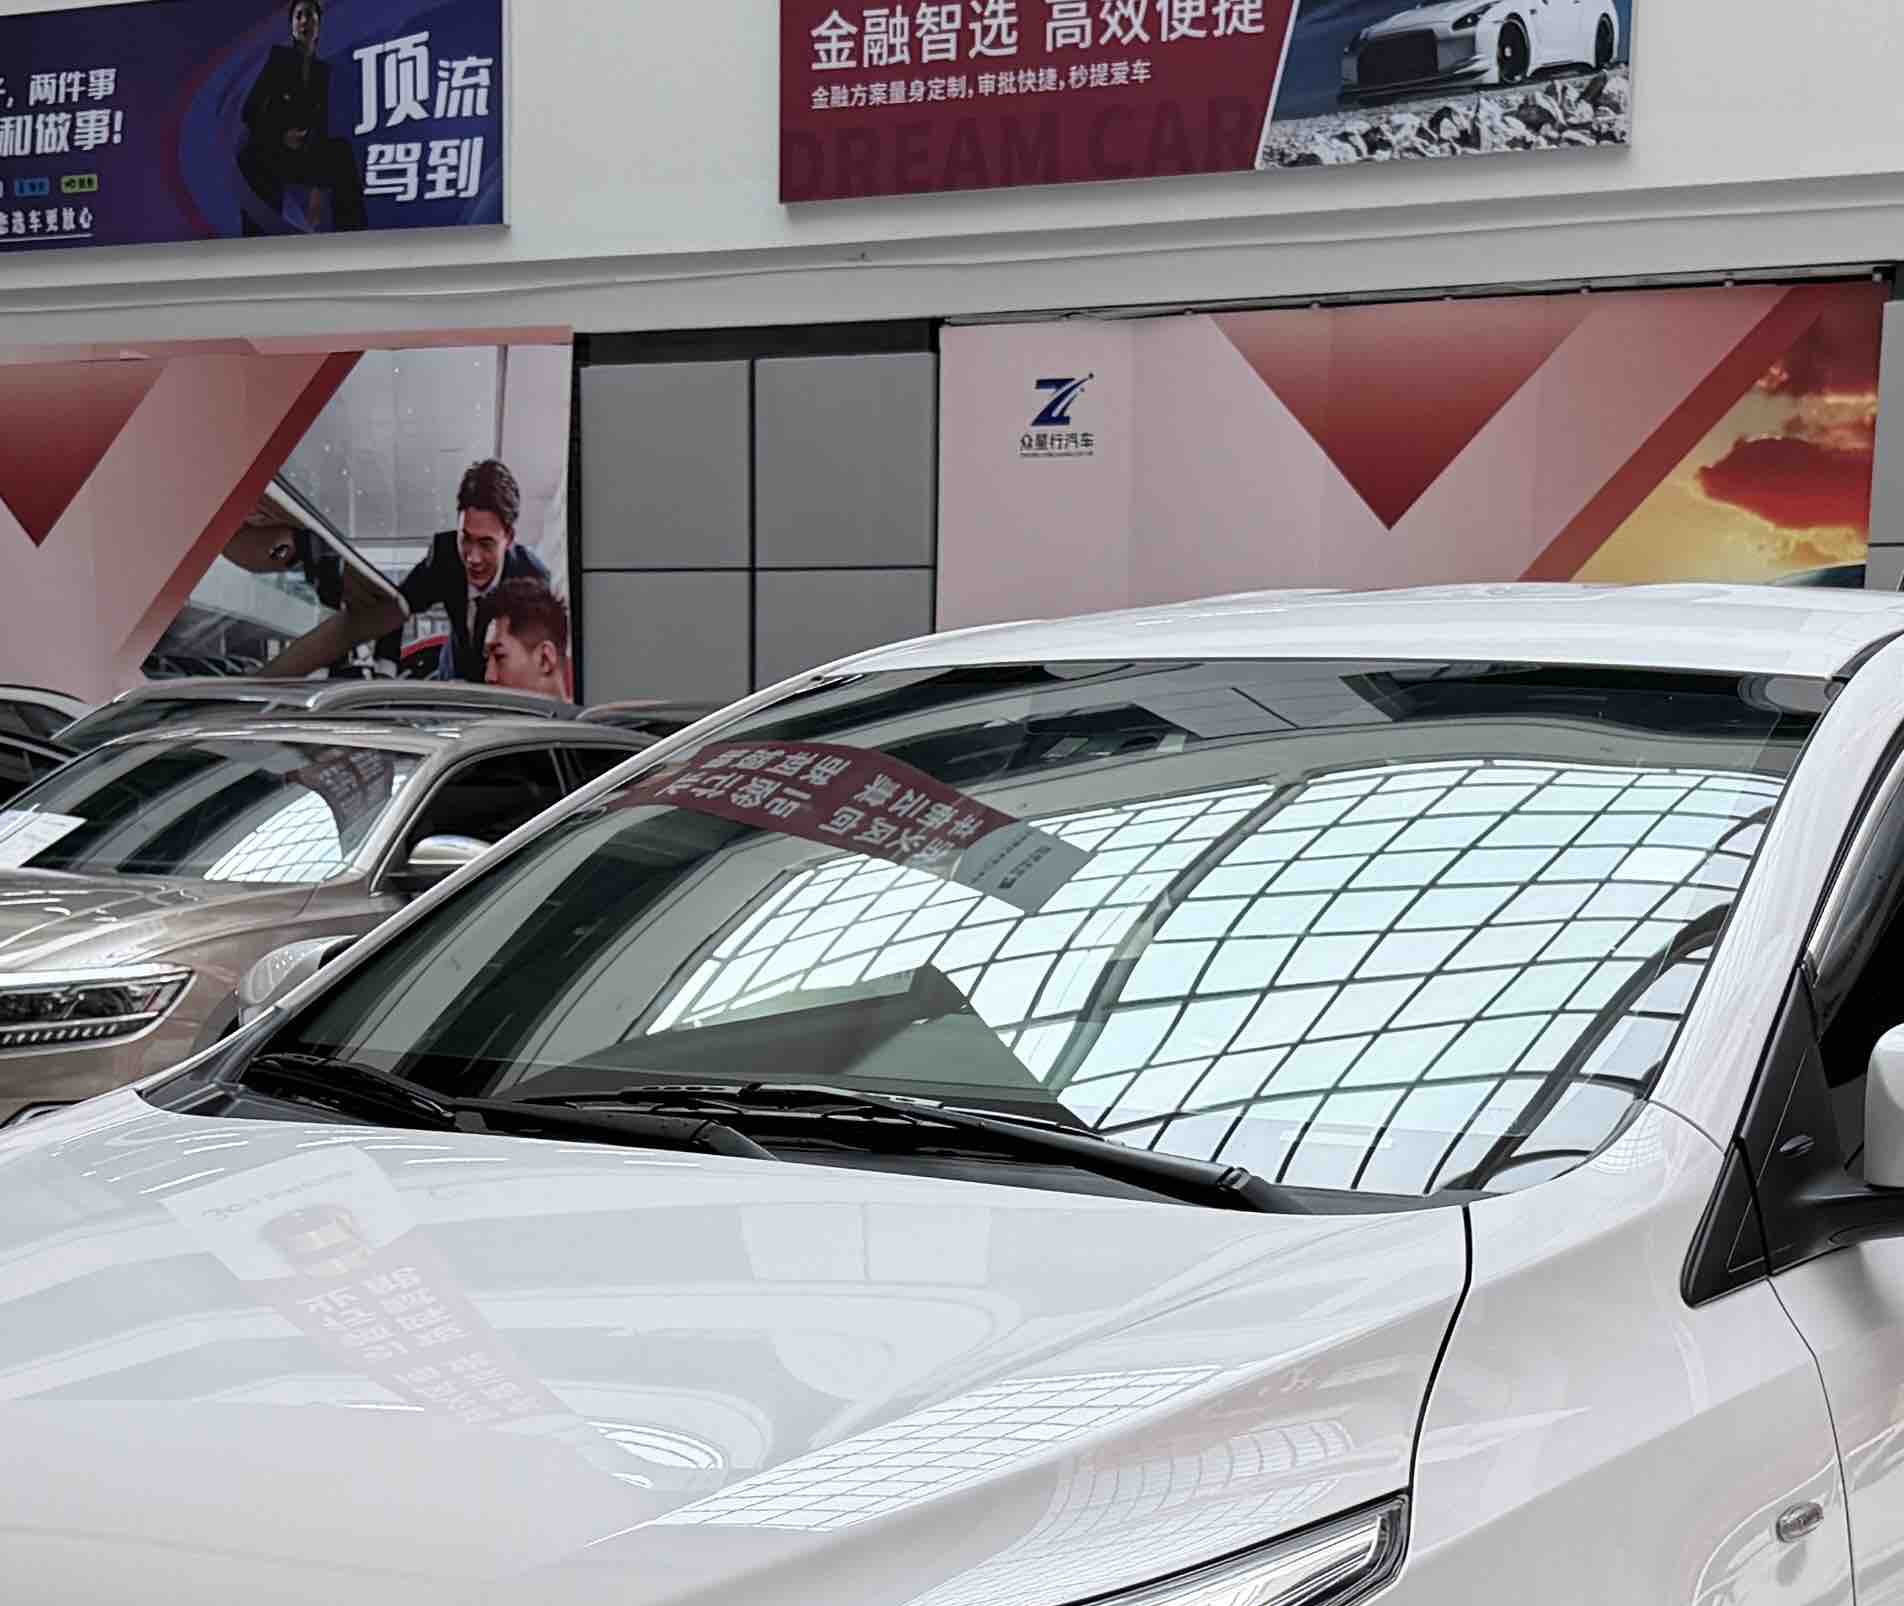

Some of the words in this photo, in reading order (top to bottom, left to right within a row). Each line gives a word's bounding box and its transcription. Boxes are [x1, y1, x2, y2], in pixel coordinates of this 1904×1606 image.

[810, 0, 1018, 71] 金融智选
[353, 31, 494, 136] 顶流
[363, 136, 484, 202] 驾到
[1019, 432, 1095, 450] 众星行汽车
